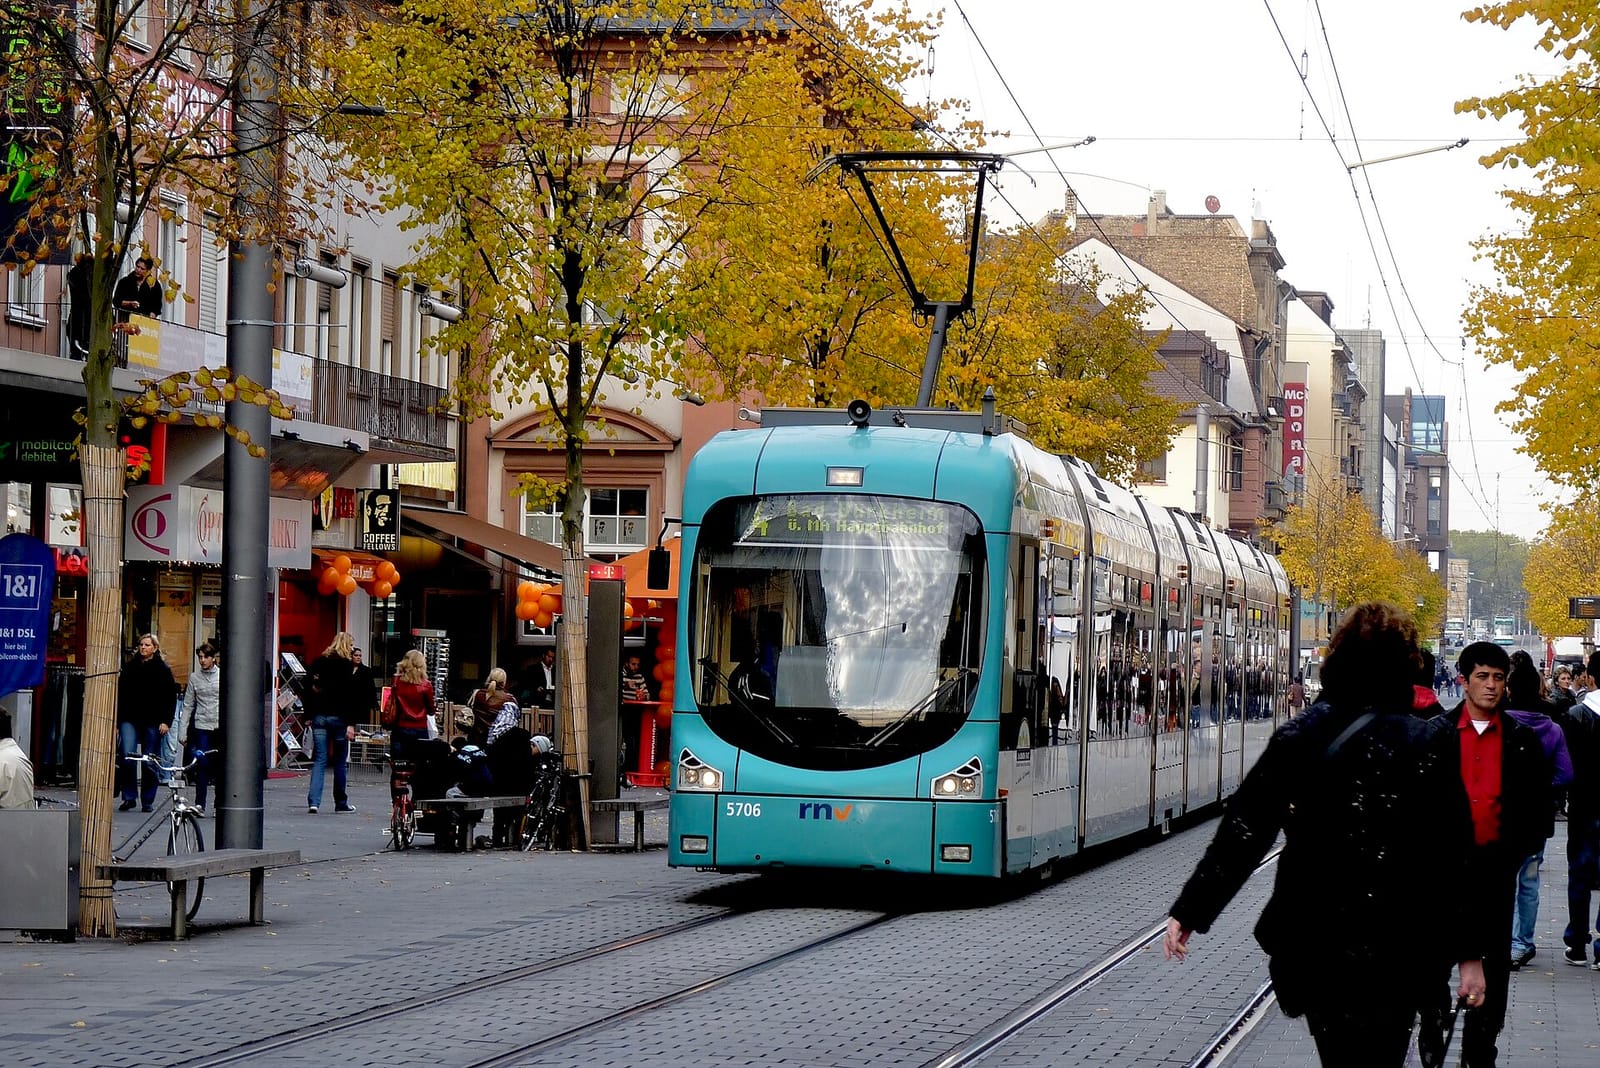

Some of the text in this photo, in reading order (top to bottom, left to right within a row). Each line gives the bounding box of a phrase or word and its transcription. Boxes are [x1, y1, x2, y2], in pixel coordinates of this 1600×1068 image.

[21, 440, 74, 451] mobilco
[21, 452, 57, 462] debitel
[363, 533, 396, 544] COFFEE
[363, 543, 396, 551] FELLOWS
[3, 574, 37, 598] 1&1
[17, 628, 36, 639] DSL
[726, 802, 853, 822] 5706 rnv
